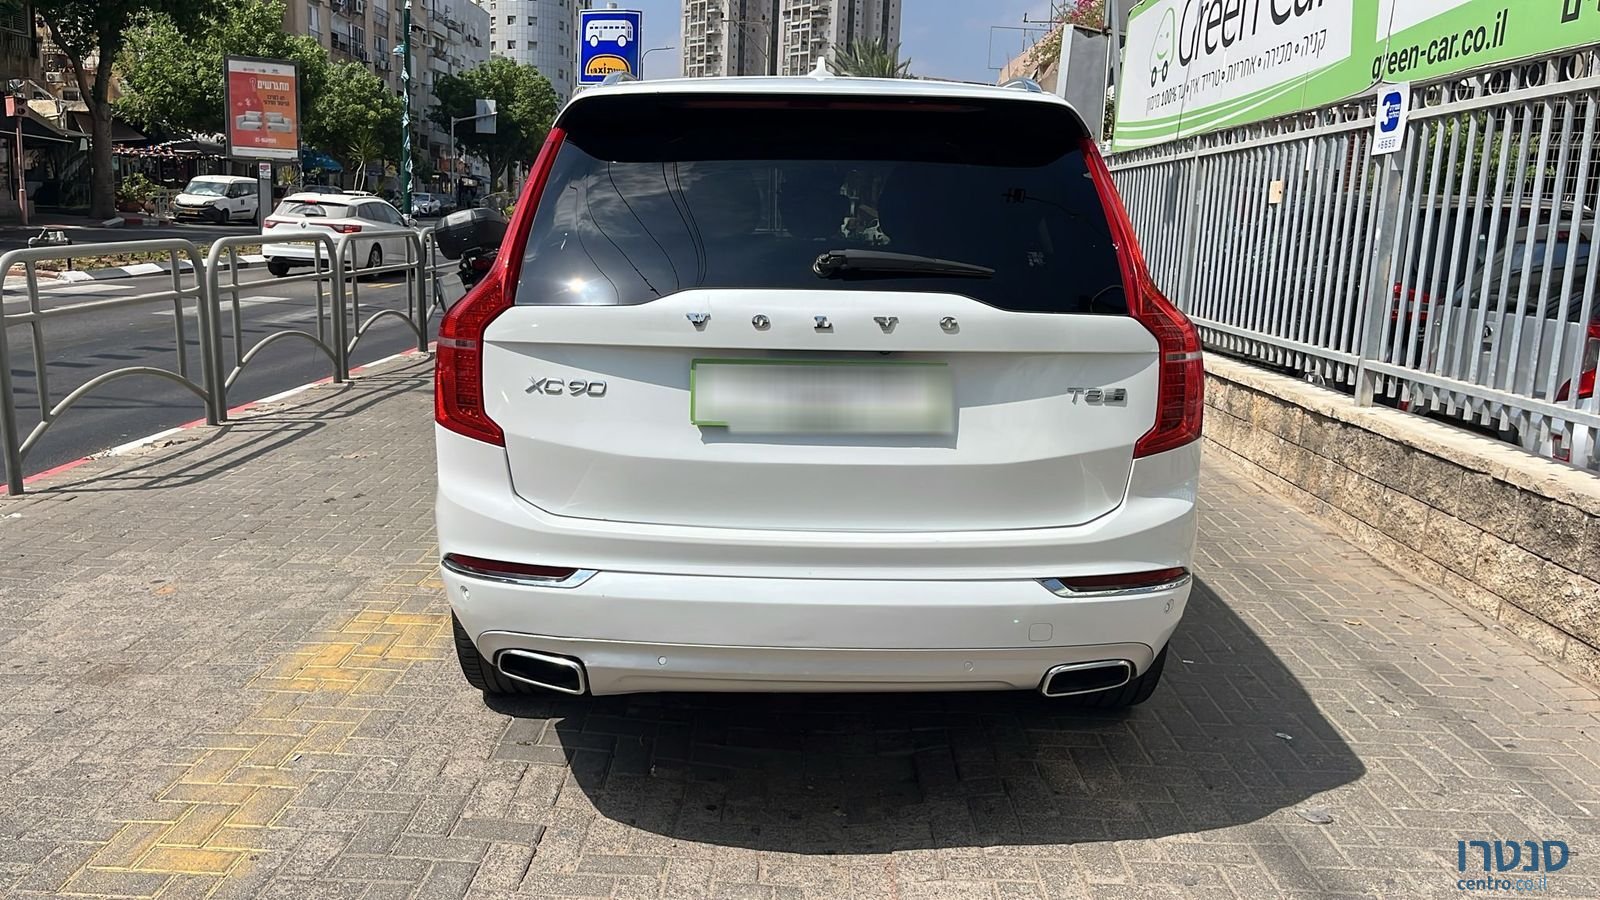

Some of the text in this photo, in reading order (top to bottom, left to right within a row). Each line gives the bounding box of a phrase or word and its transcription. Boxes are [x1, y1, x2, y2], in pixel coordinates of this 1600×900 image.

[1263, 41, 1293, 70] מכירה
[1301, 29, 1327, 58] קניה
[1226, 56, 1257, 83] אחריות
[686, 312, 959, 334] VOLVO
